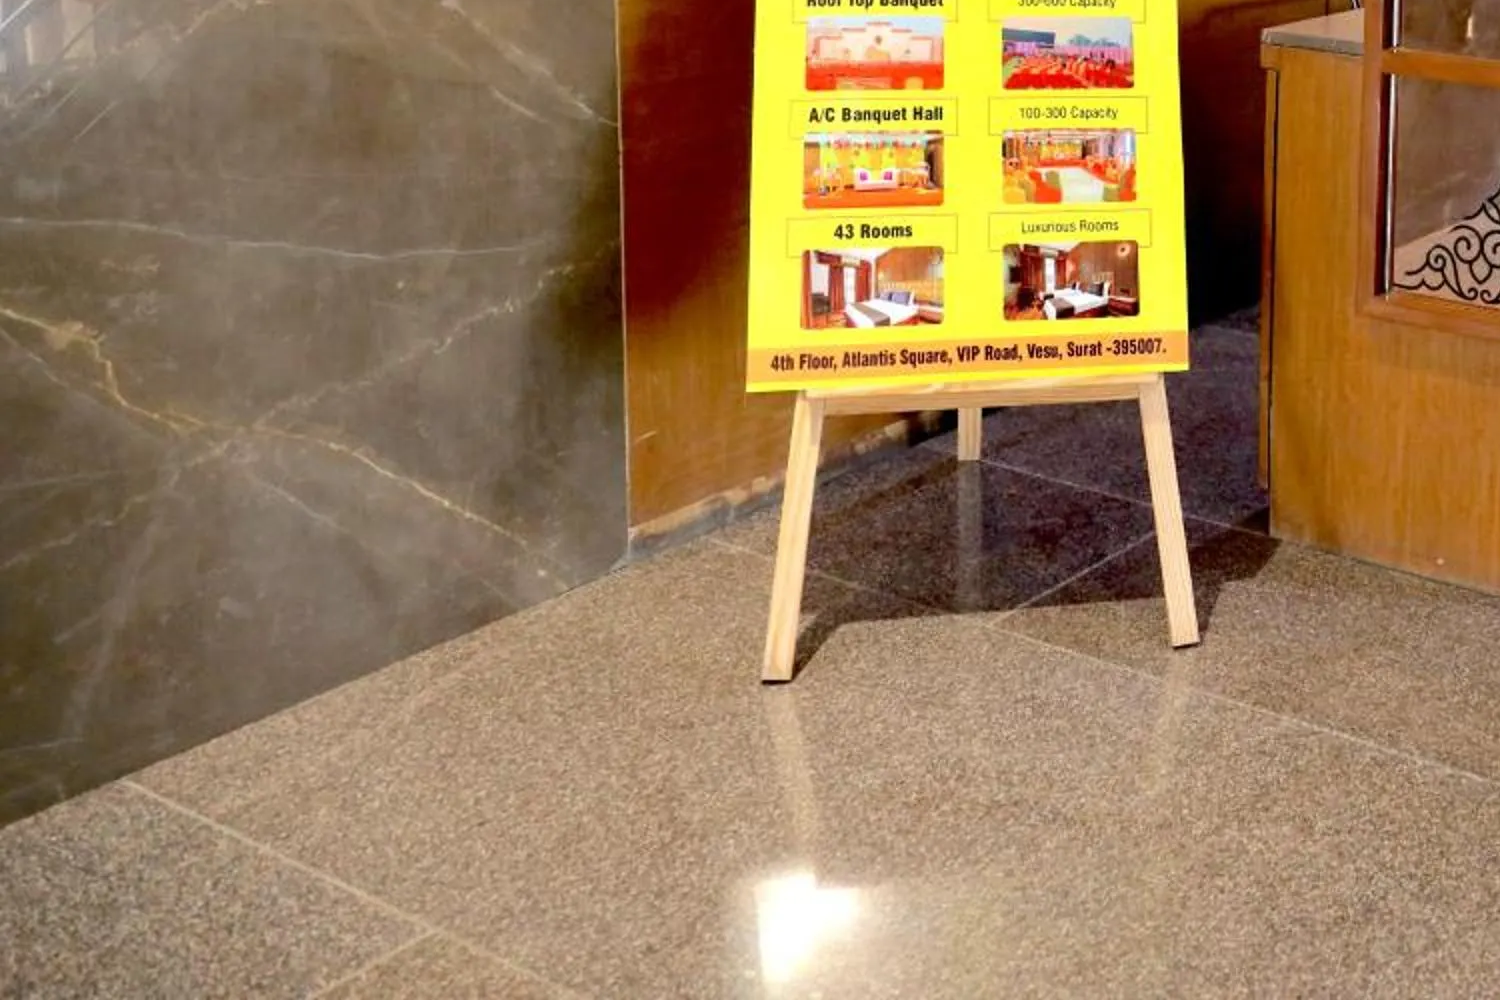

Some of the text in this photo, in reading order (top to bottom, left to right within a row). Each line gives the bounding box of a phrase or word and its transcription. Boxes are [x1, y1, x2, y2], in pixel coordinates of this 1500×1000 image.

[808, 105, 943, 124] A/C Banquet Hall
[1019, 105, 1119, 120] 100-300 Capacity
[833, 223, 913, 240] 43 Rooms
[1079, 219, 1119, 232] Rooms
[771, 354, 795, 371] 4th
[800, 353, 837, 371] Floor,
[842, 351, 897, 368] Atlantis
[899, 349, 952, 368] Square,
[957, 345, 980, 362] VIP
[985, 345, 1022, 361] Road,
[1027, 343, 1063, 360] Vesu,
[1067, 340, 1103, 357] Surat
